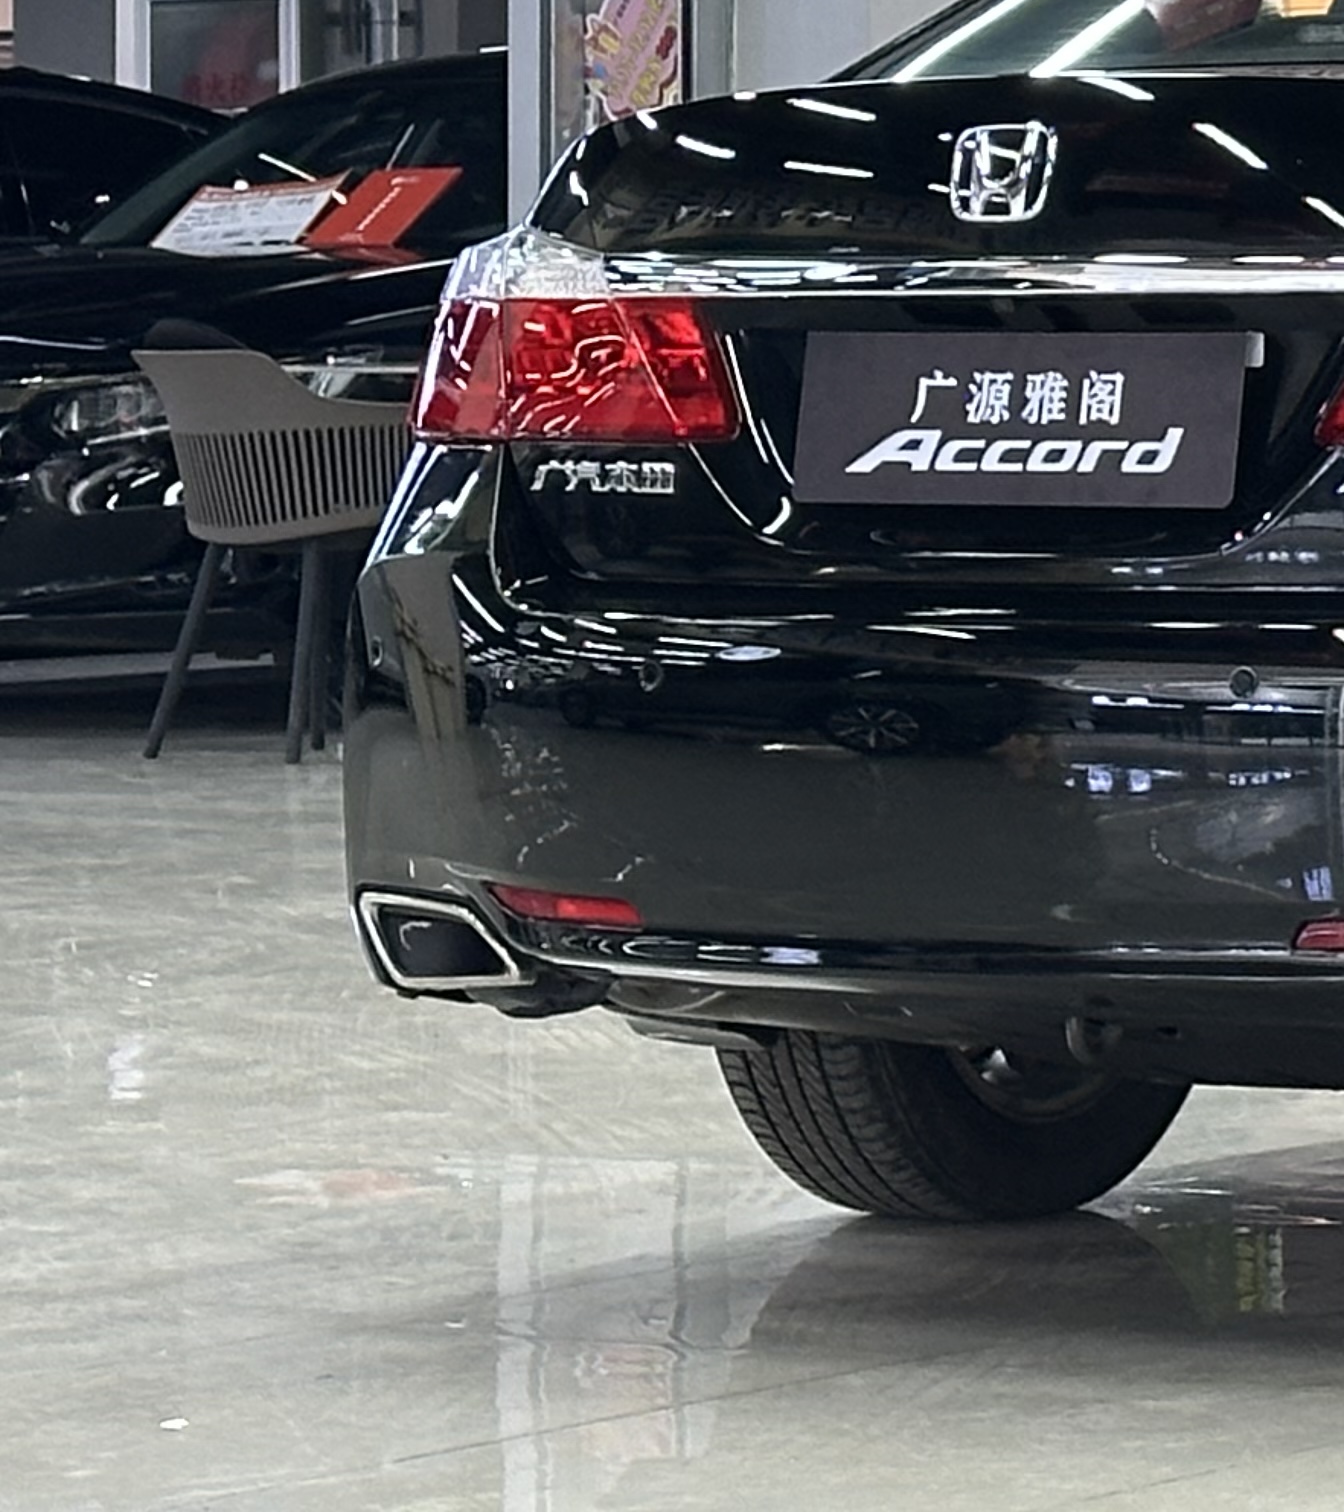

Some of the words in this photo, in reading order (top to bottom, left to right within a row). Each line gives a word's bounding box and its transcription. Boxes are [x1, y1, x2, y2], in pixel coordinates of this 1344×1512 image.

[911, 370, 1124, 425] 广源雅阁
[846, 427, 1184, 475] Accord
[530, 459, 676, 494] 广汽本田
